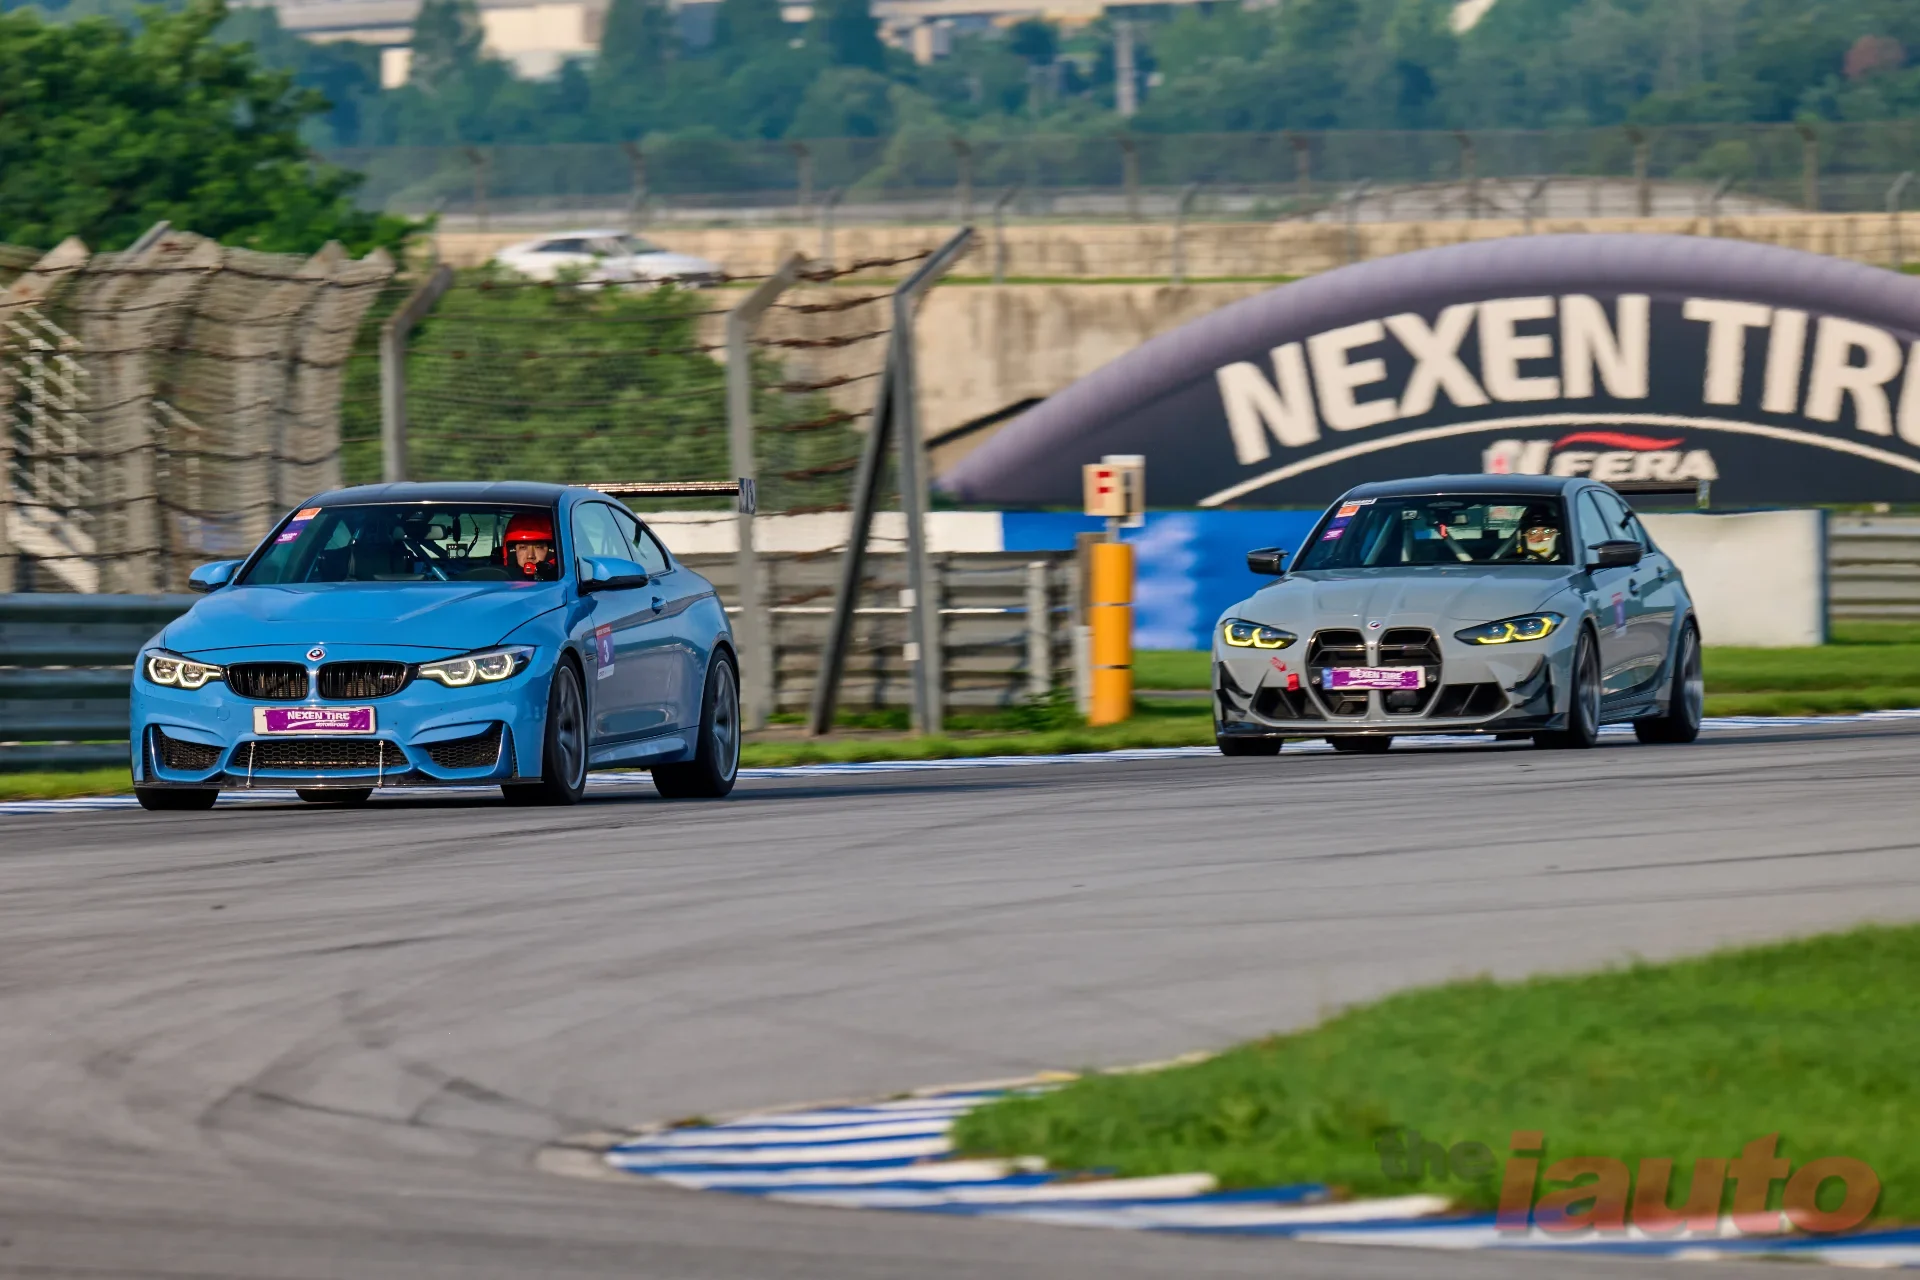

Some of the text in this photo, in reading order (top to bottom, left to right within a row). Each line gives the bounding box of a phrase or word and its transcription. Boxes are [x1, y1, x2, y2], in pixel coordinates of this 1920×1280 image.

[1216, 293, 1651, 466] NEXEN
[287, 711, 350, 720] NEXEN TIRE
